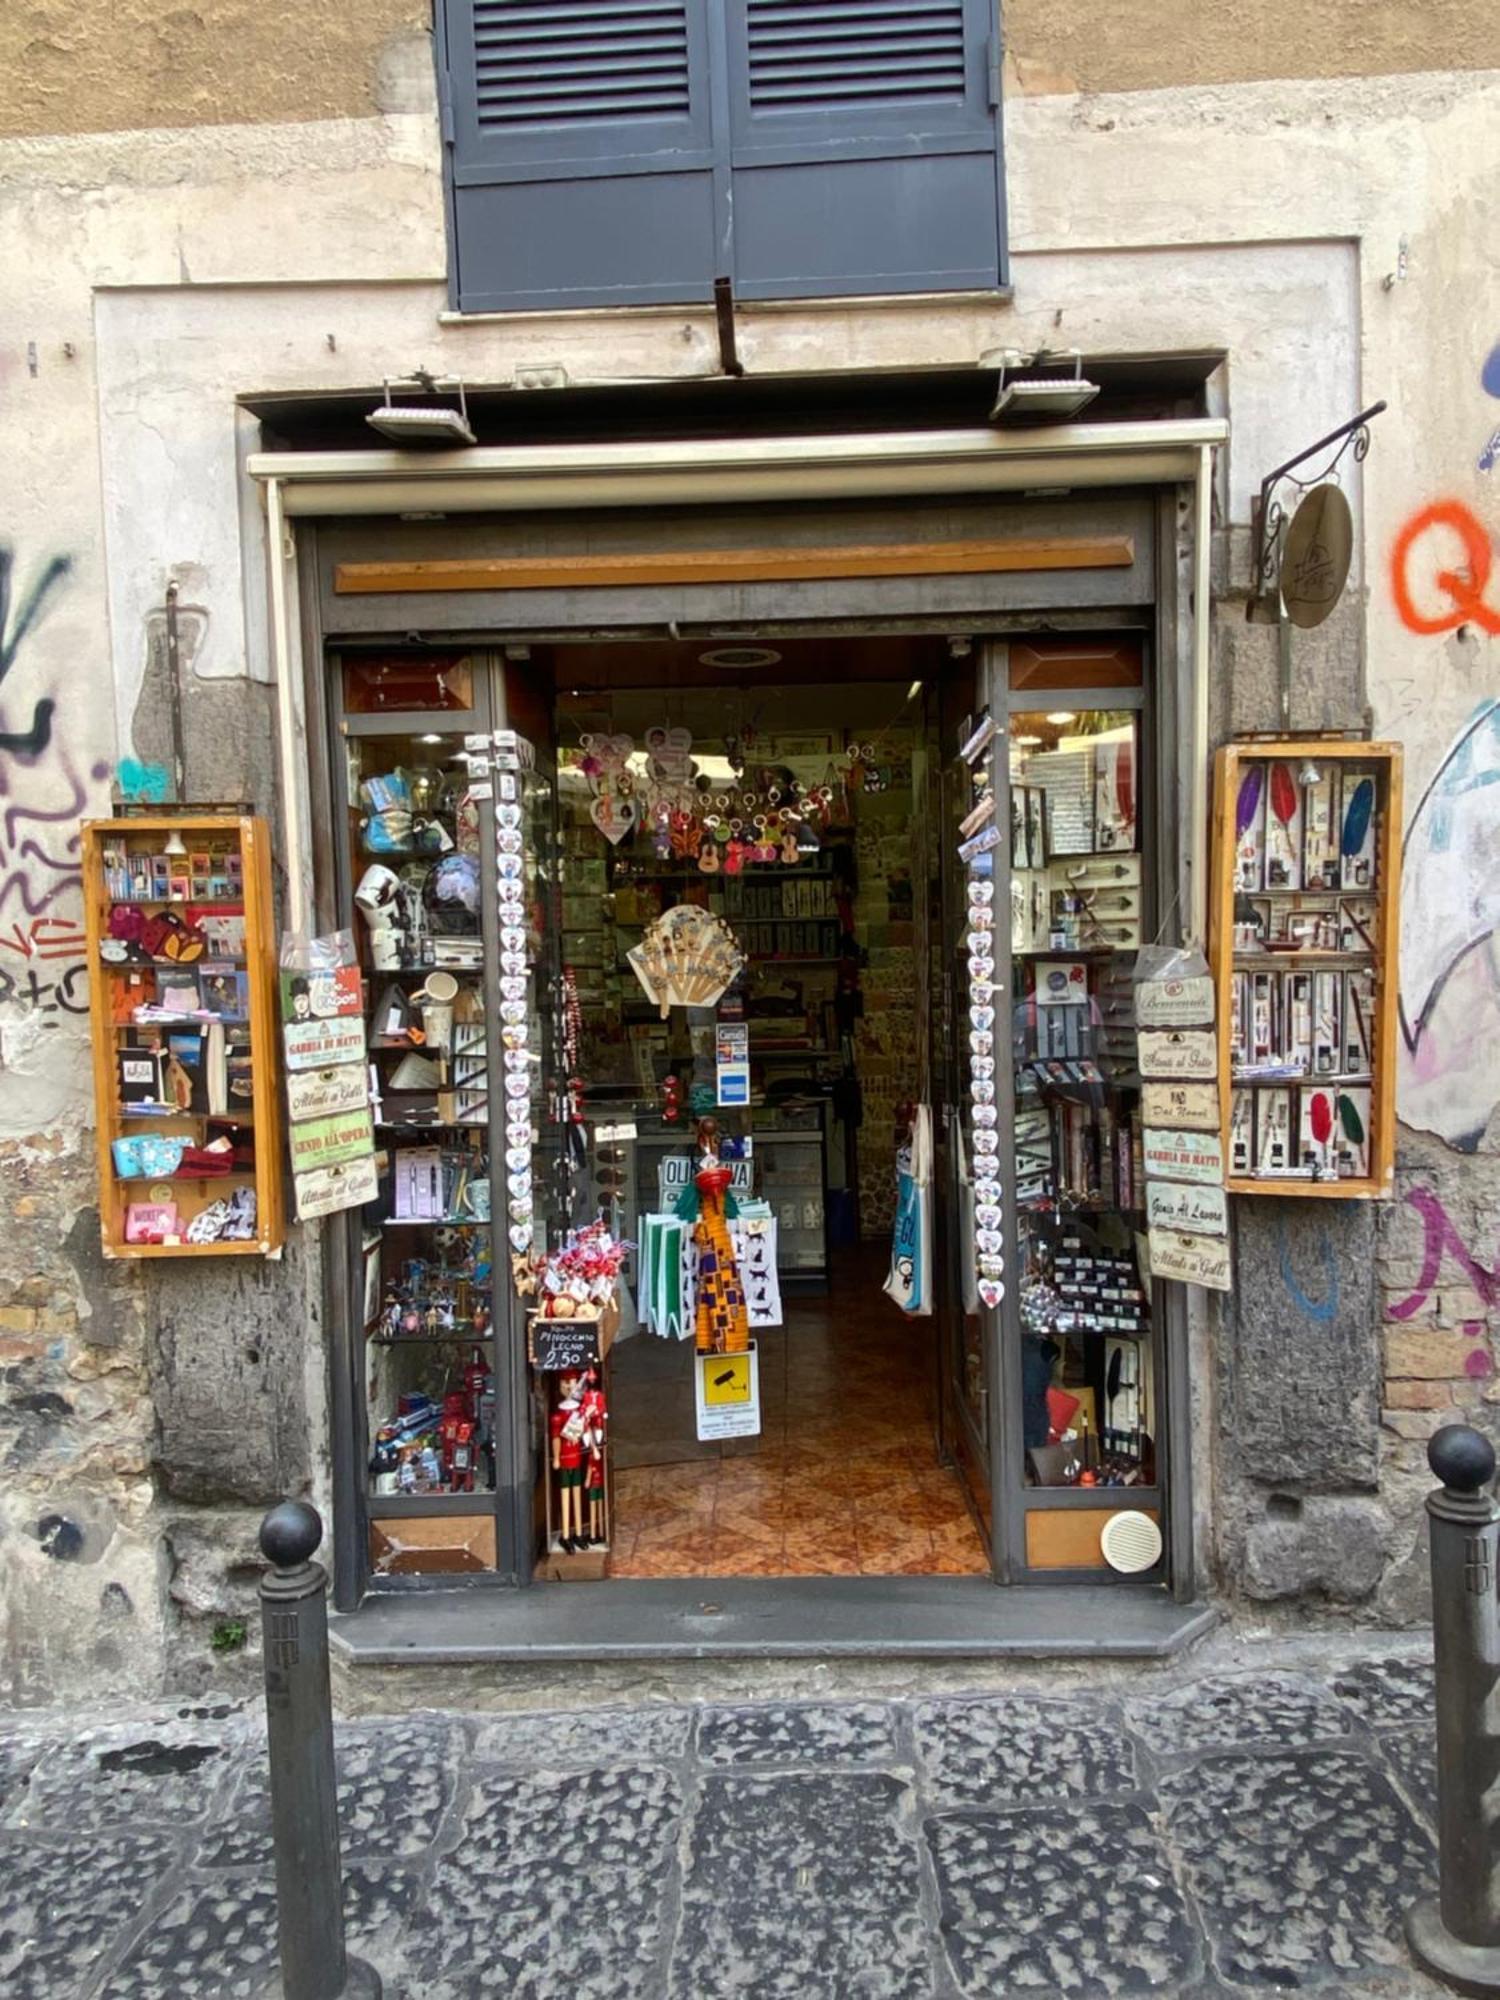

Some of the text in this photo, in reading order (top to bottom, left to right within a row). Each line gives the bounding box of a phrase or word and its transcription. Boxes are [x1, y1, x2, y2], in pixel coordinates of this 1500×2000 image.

[336, 1034, 362, 1048] MATTI
[1147, 1150, 1178, 1163] GABBIA
[1192, 1154, 1220, 1168] MATTI
[540, 1331, 595, 1342] PINOCCHIO
[551, 1341, 585, 1351] LEGNO
[543, 1350, 581, 1370] 2,50
